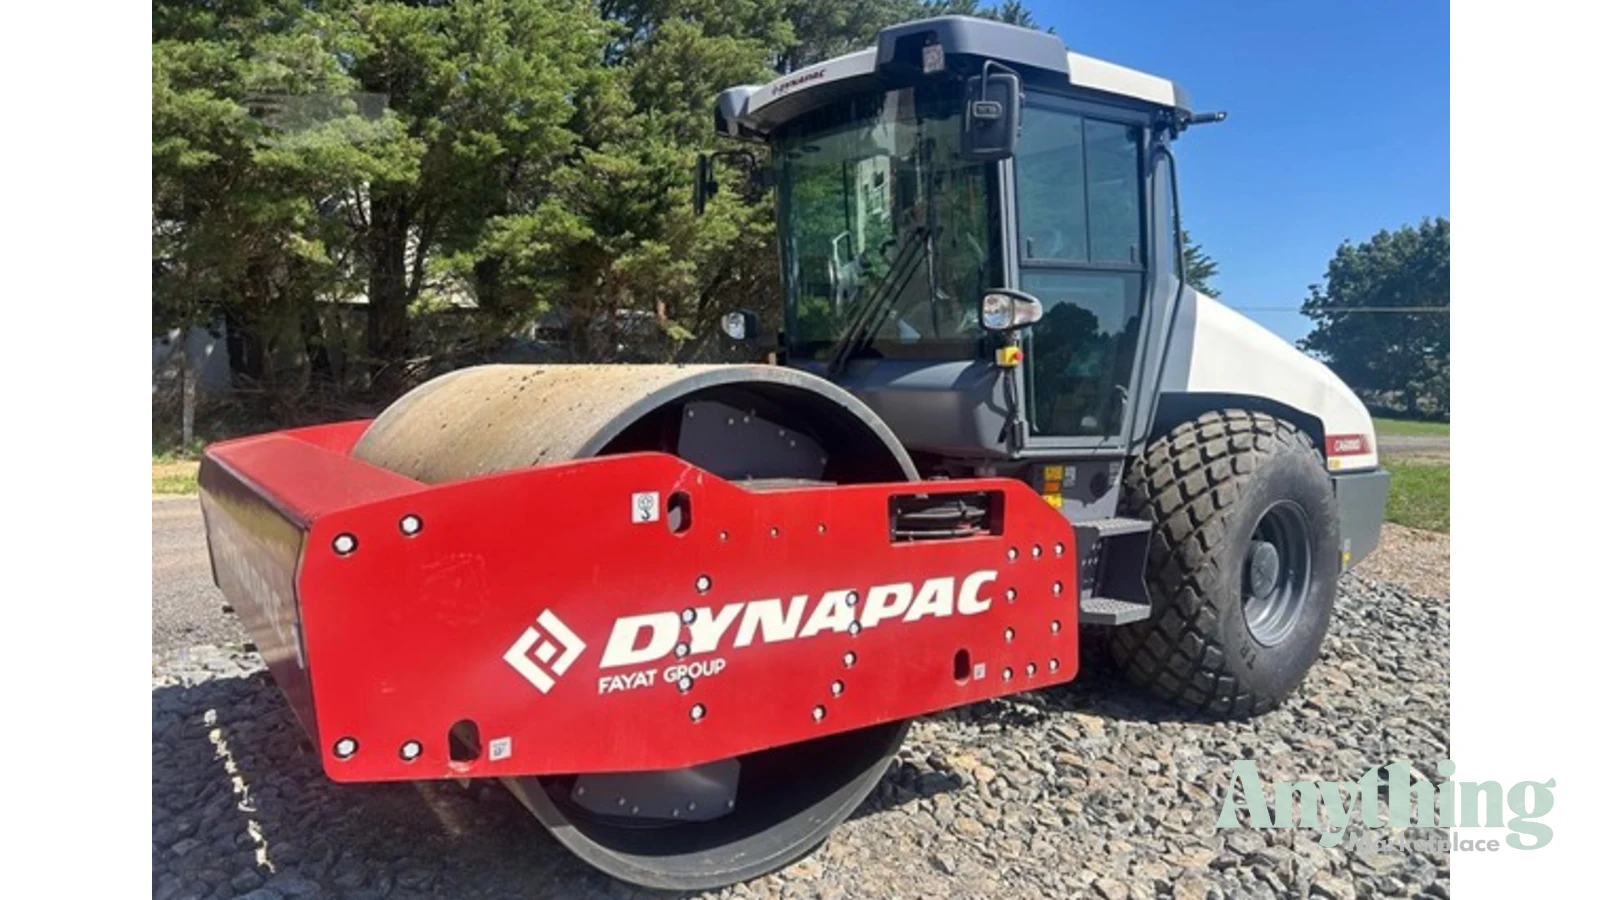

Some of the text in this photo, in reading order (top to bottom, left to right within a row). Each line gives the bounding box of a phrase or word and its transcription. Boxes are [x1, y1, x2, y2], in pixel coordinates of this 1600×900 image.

[599, 570, 998, 669] DYNAPAC
[598, 657, 726, 694] FAYAT GROUP
